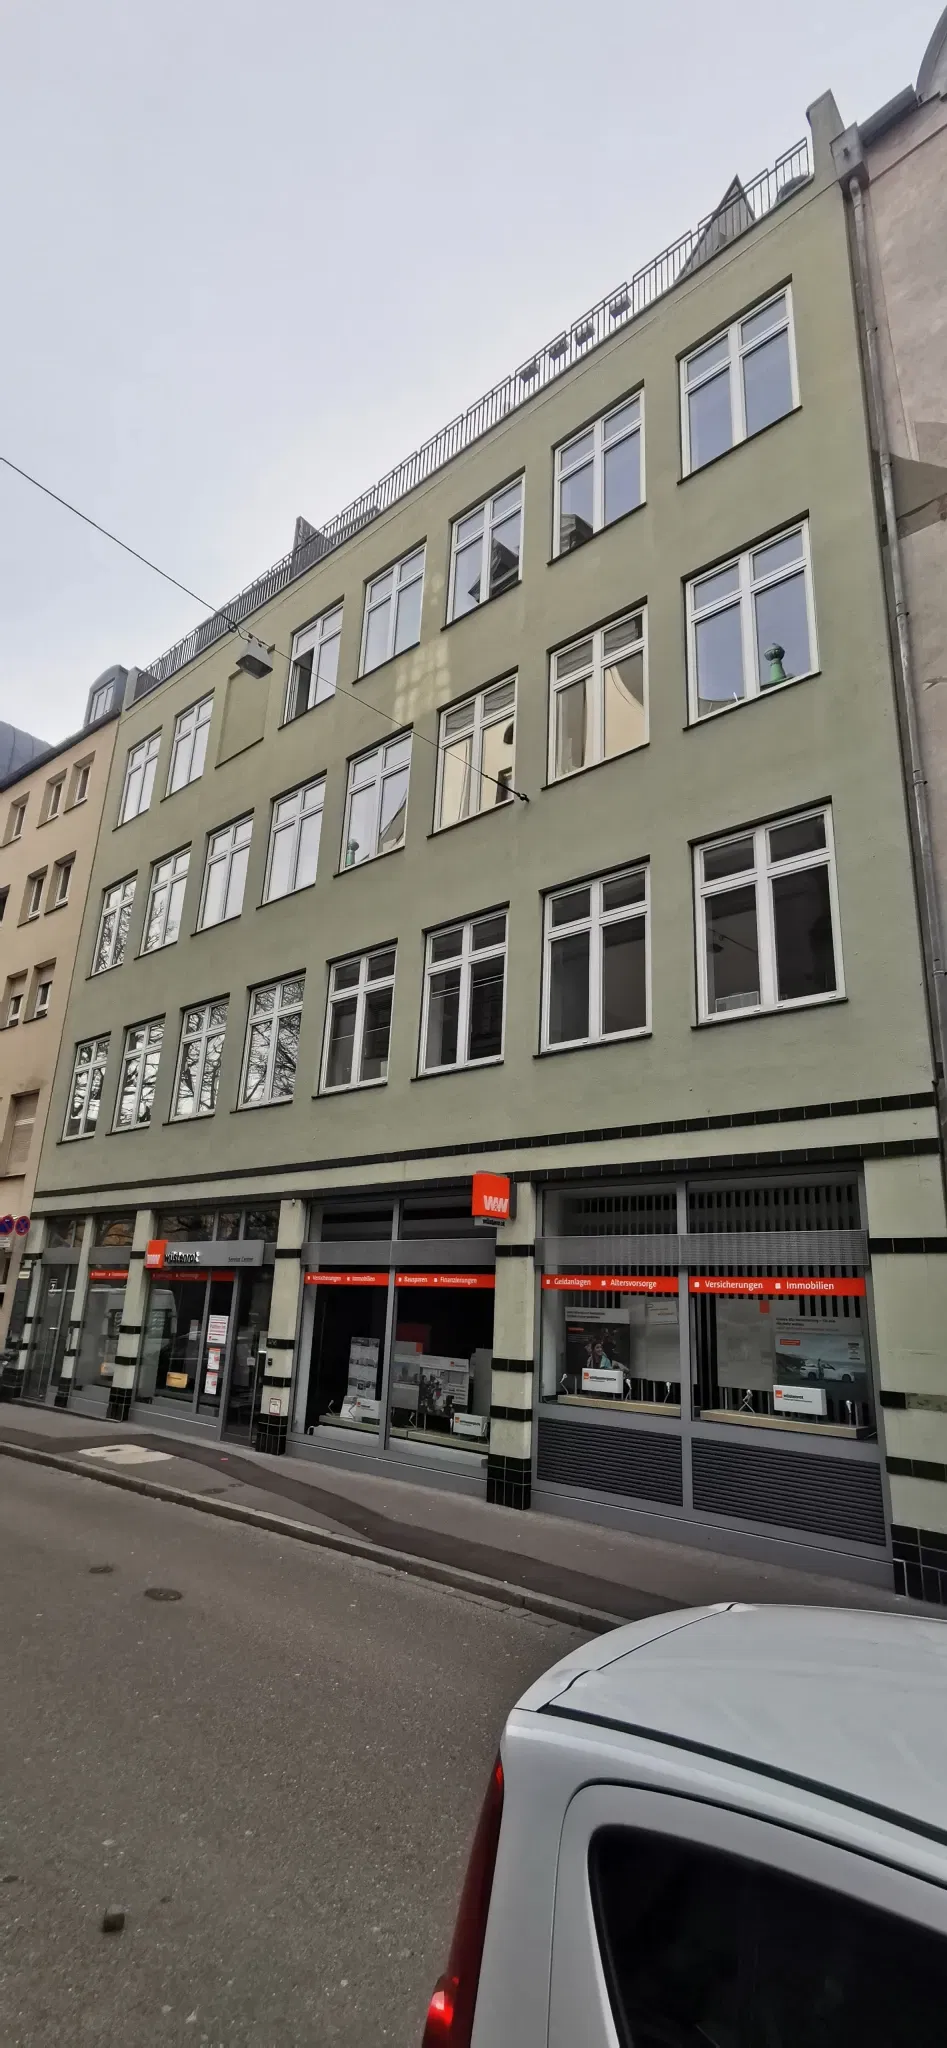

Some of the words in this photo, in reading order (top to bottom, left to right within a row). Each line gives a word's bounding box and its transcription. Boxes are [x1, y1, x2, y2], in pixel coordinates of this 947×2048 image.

[404, 1276, 428, 1284] Bausparen
[440, 1276, 477, 1285] Finanzierungen
[554, 1278, 591, 1287] Geldanlagen
[610, 1279, 657, 1289] Altersvorsorge
[704, 1280, 763, 1291] Versicherungen
[786, 1281, 834, 1290] Immobilien
